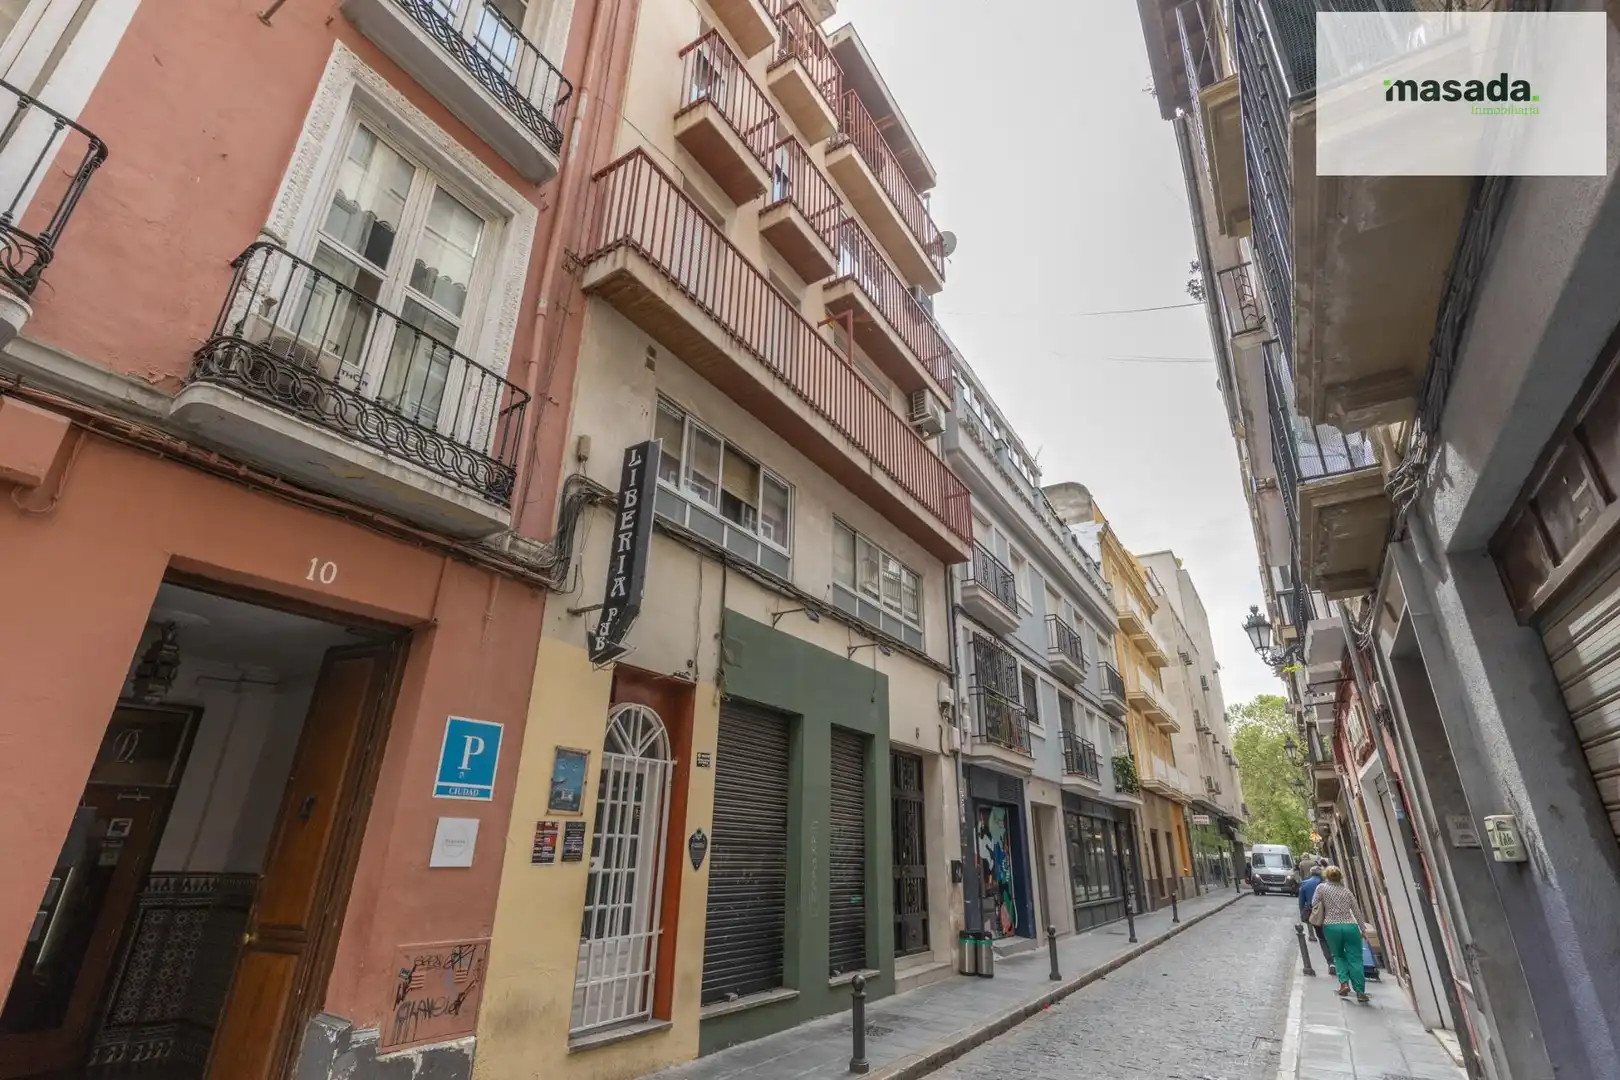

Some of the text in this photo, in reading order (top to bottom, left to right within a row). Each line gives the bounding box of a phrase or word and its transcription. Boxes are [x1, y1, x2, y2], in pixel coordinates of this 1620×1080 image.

[594, 449, 642, 651] LIBERIA PUB
[305, 557, 338, 584] 10
[457, 734, 486, 771] P
[448, 787, 480, 797] CIUDAD
